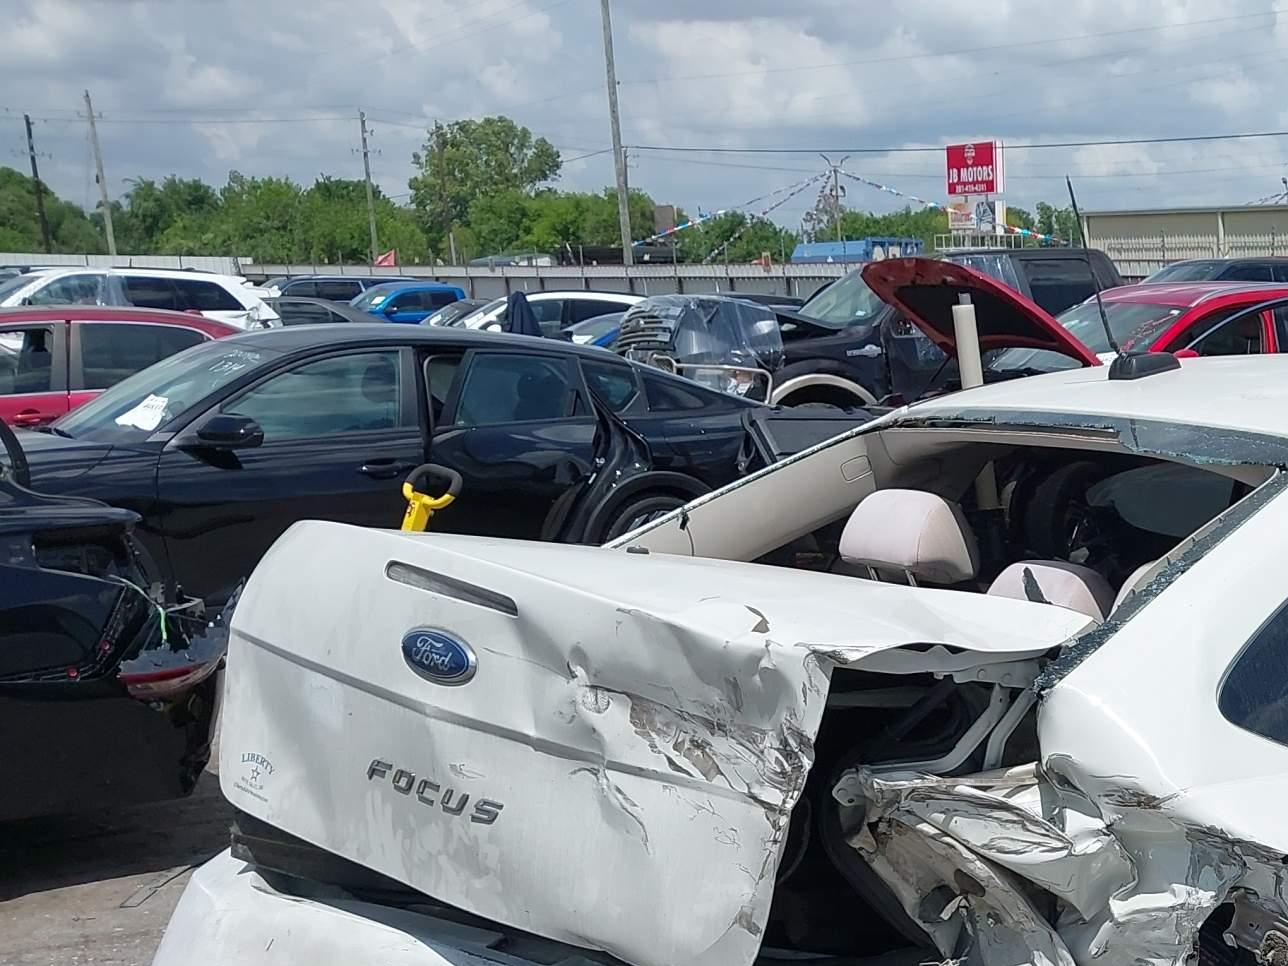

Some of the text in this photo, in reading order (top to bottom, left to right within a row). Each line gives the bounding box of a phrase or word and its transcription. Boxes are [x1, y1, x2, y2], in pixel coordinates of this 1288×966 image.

[949, 165, 994, 184] JB MOTORS
[411, 635, 451, 672] Ford
[241, 752, 276, 776] LIBERTY
[366, 758, 505, 826] FOCUS
